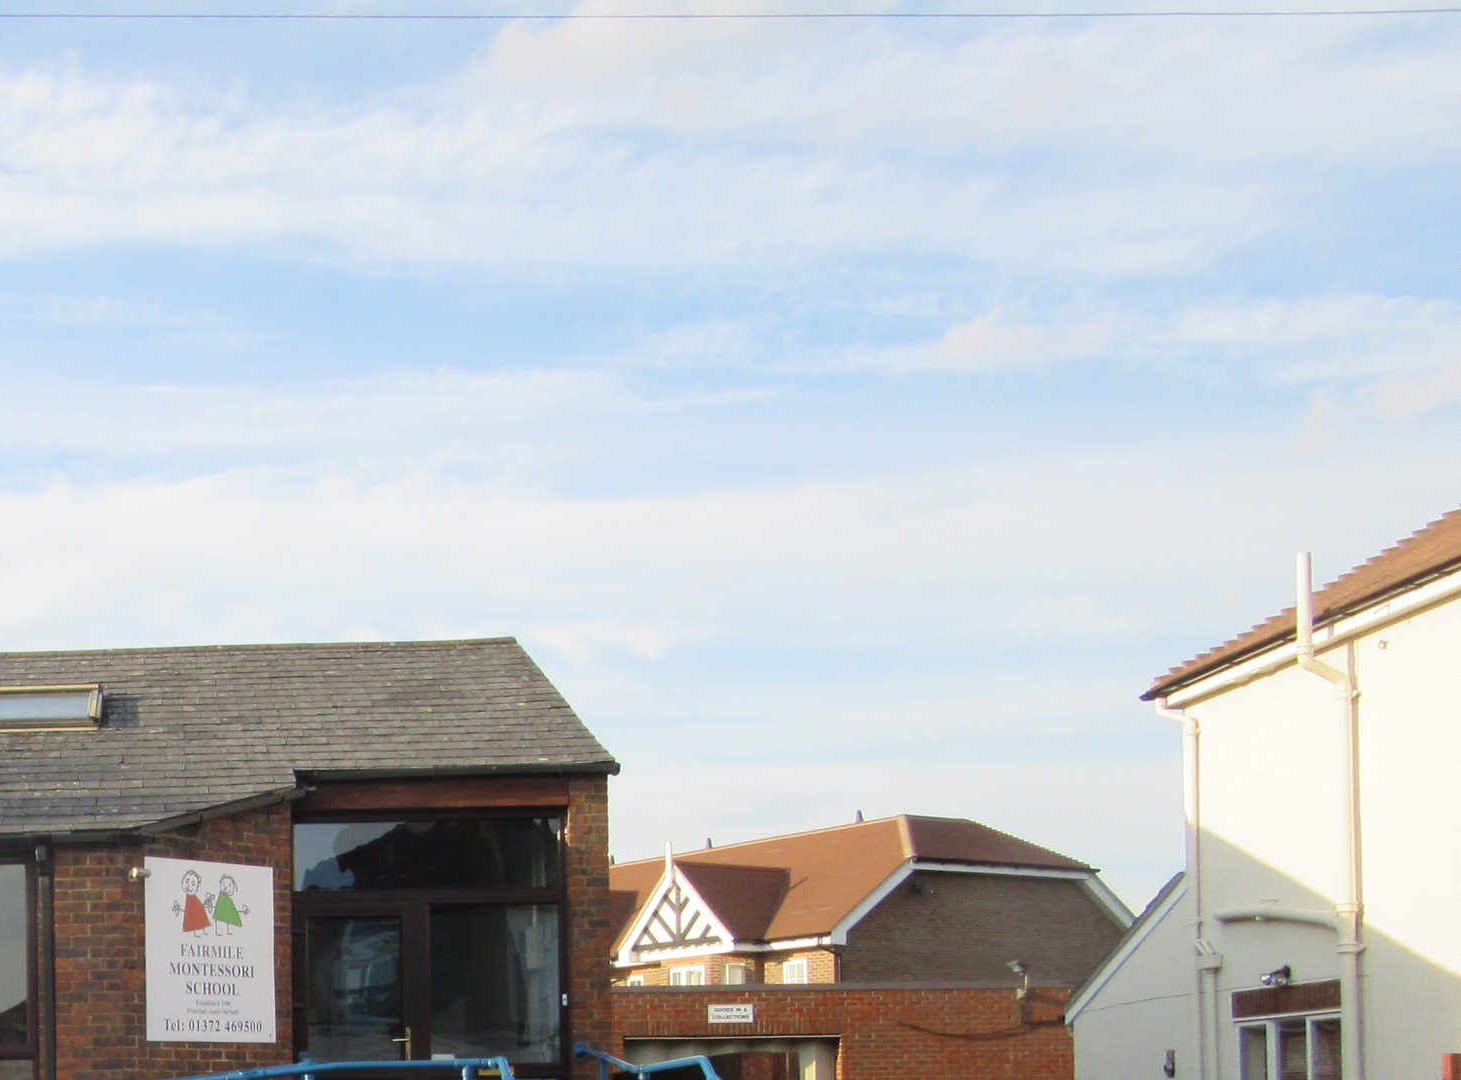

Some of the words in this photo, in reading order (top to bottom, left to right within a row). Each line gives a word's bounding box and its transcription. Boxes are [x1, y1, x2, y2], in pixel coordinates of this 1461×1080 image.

[180, 943, 244, 960] FAIRMILE
[169, 962, 255, 979] MONTESSORI
[185, 981, 240, 997] SCHOOL
[163, 1018, 185, 1032] Tel:
[188, 1019, 220, 1032] 01372
[224, 1020, 262, 1033] 469500
